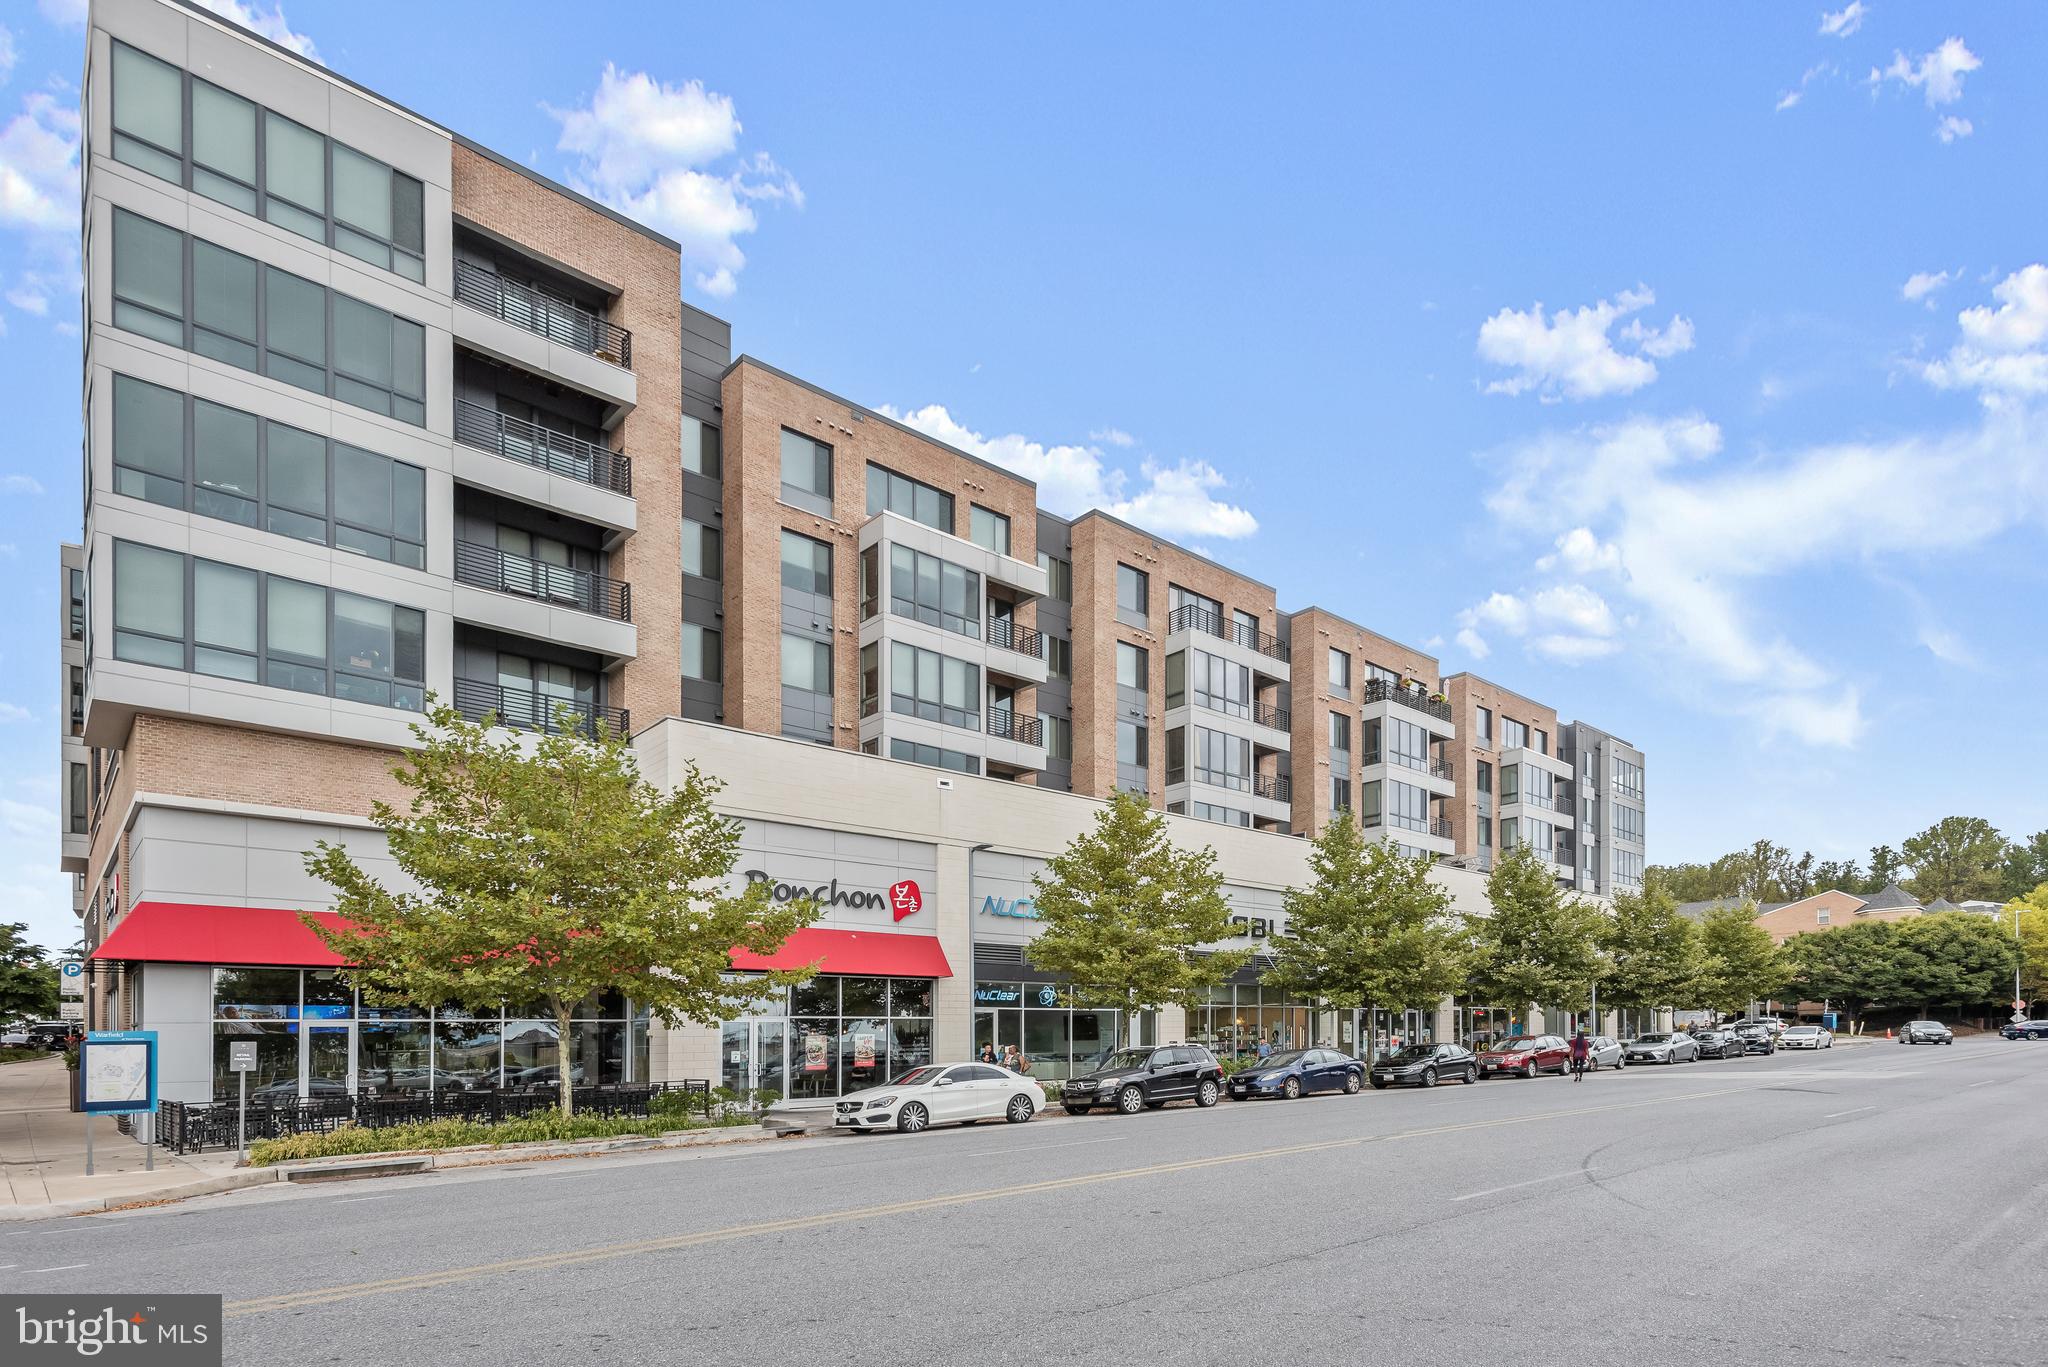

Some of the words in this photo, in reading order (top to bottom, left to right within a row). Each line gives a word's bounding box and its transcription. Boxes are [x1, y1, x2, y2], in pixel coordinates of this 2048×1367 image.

[894, 884, 918, 912] 본촌
[68, 965, 79, 975] P
[974, 989, 1020, 1001] NuClear
